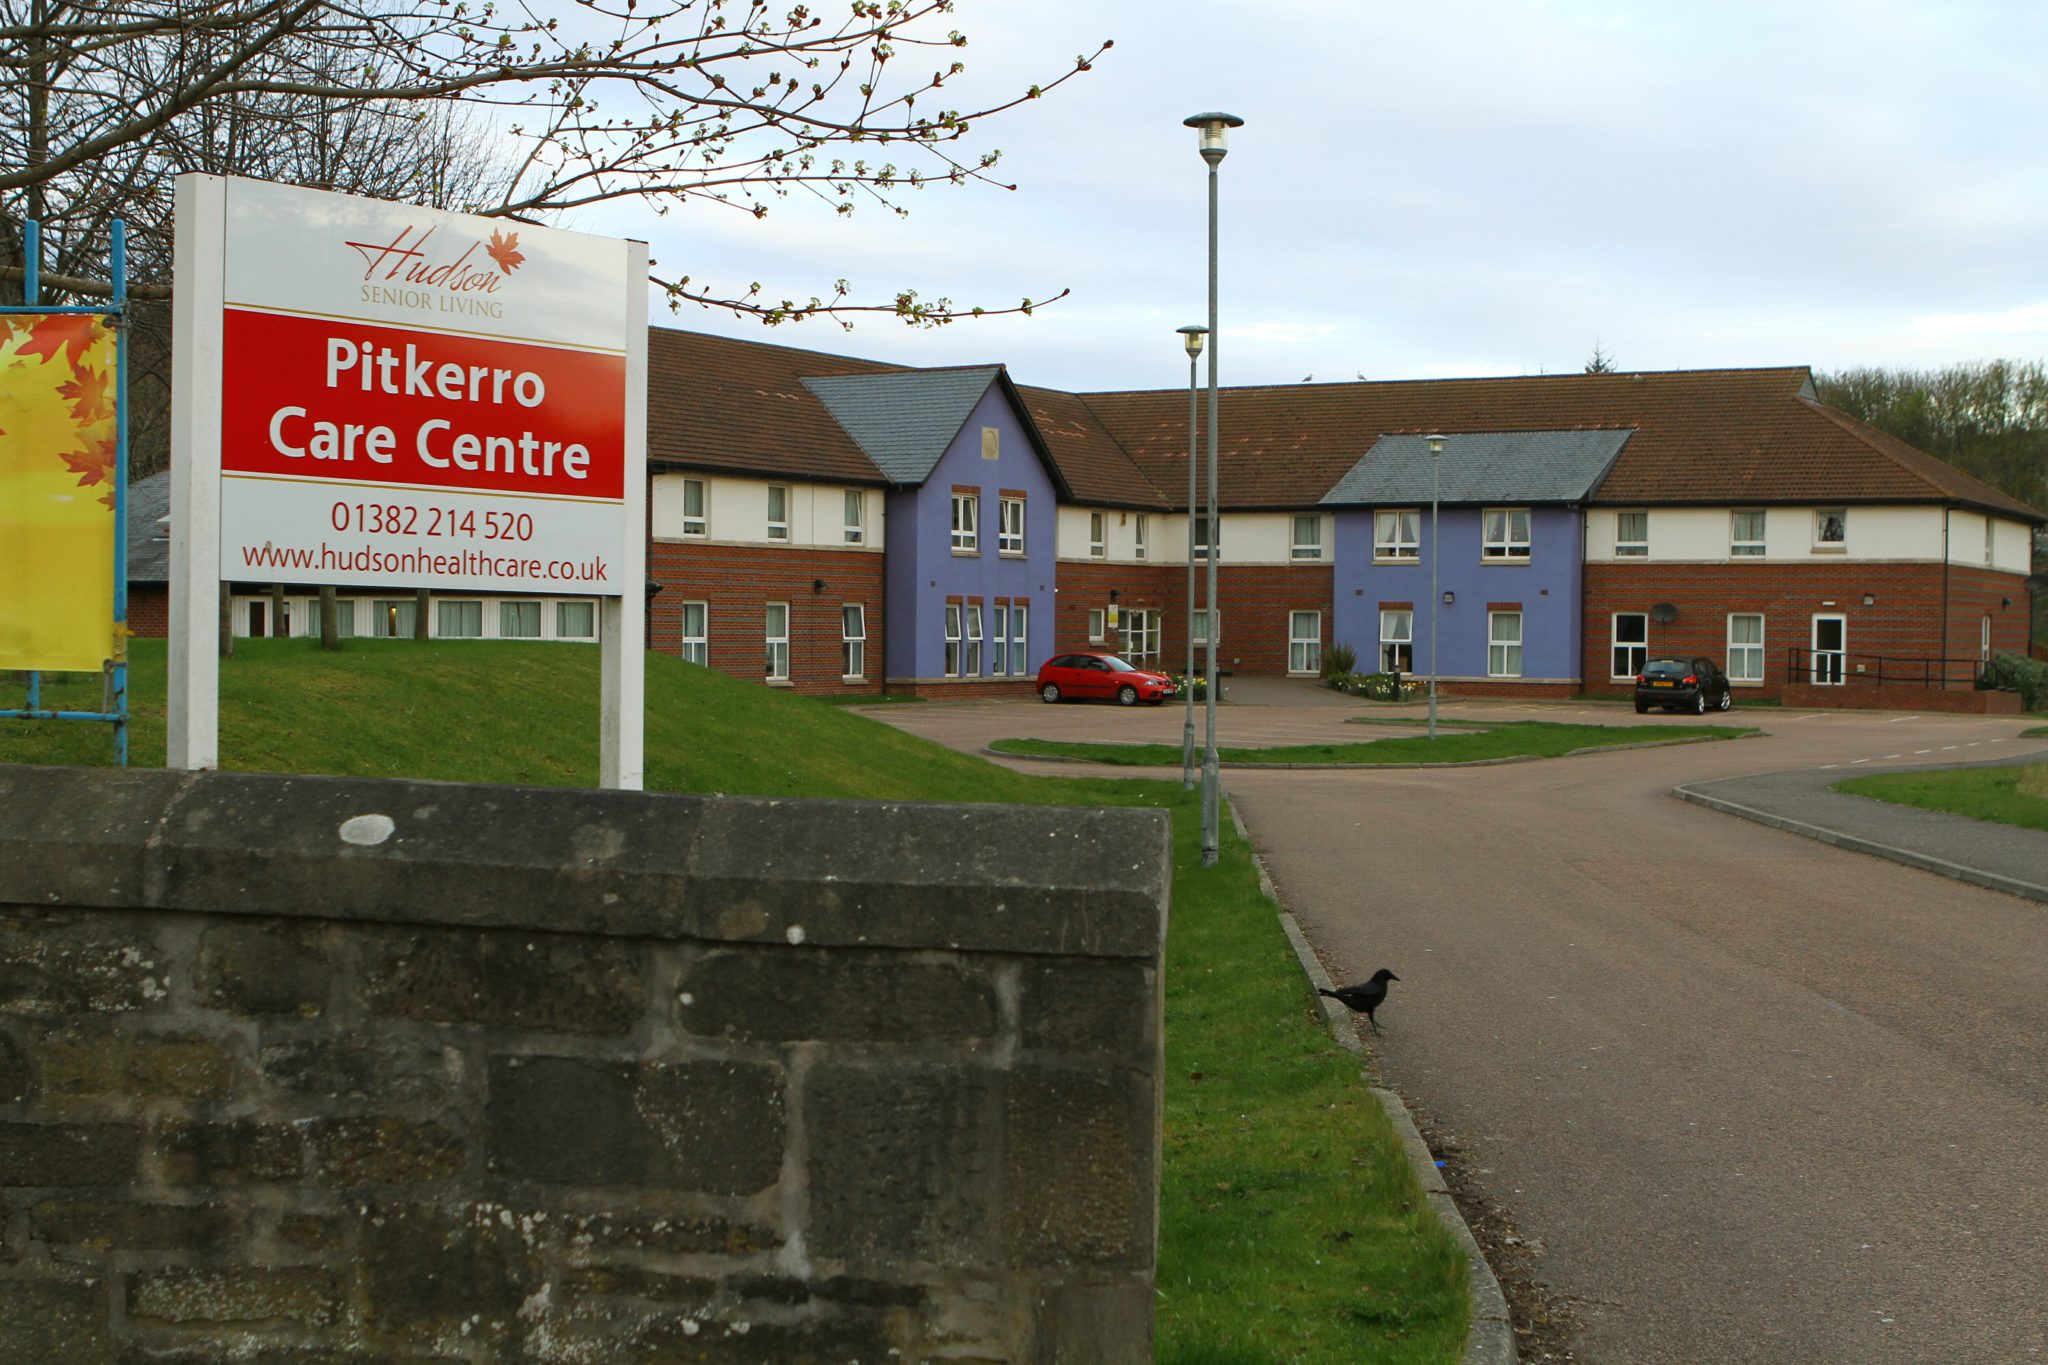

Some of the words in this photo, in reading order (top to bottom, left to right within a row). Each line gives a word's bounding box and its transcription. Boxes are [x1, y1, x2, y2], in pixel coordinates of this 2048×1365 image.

[345, 225, 503, 293] Hudson
[361, 284, 434, 311] SENIOR
[439, 293, 503, 319] LIVING
[326, 337, 546, 408] Pitkerro
[268, 405, 396, 463] Care
[416, 418, 591, 479] Centre
[332, 502, 417, 535] 01382
[427, 508, 476, 538] 214
[485, 511, 533, 541] 520
[242, 541, 608, 581] www.hudsonhealthcare.co.uk
